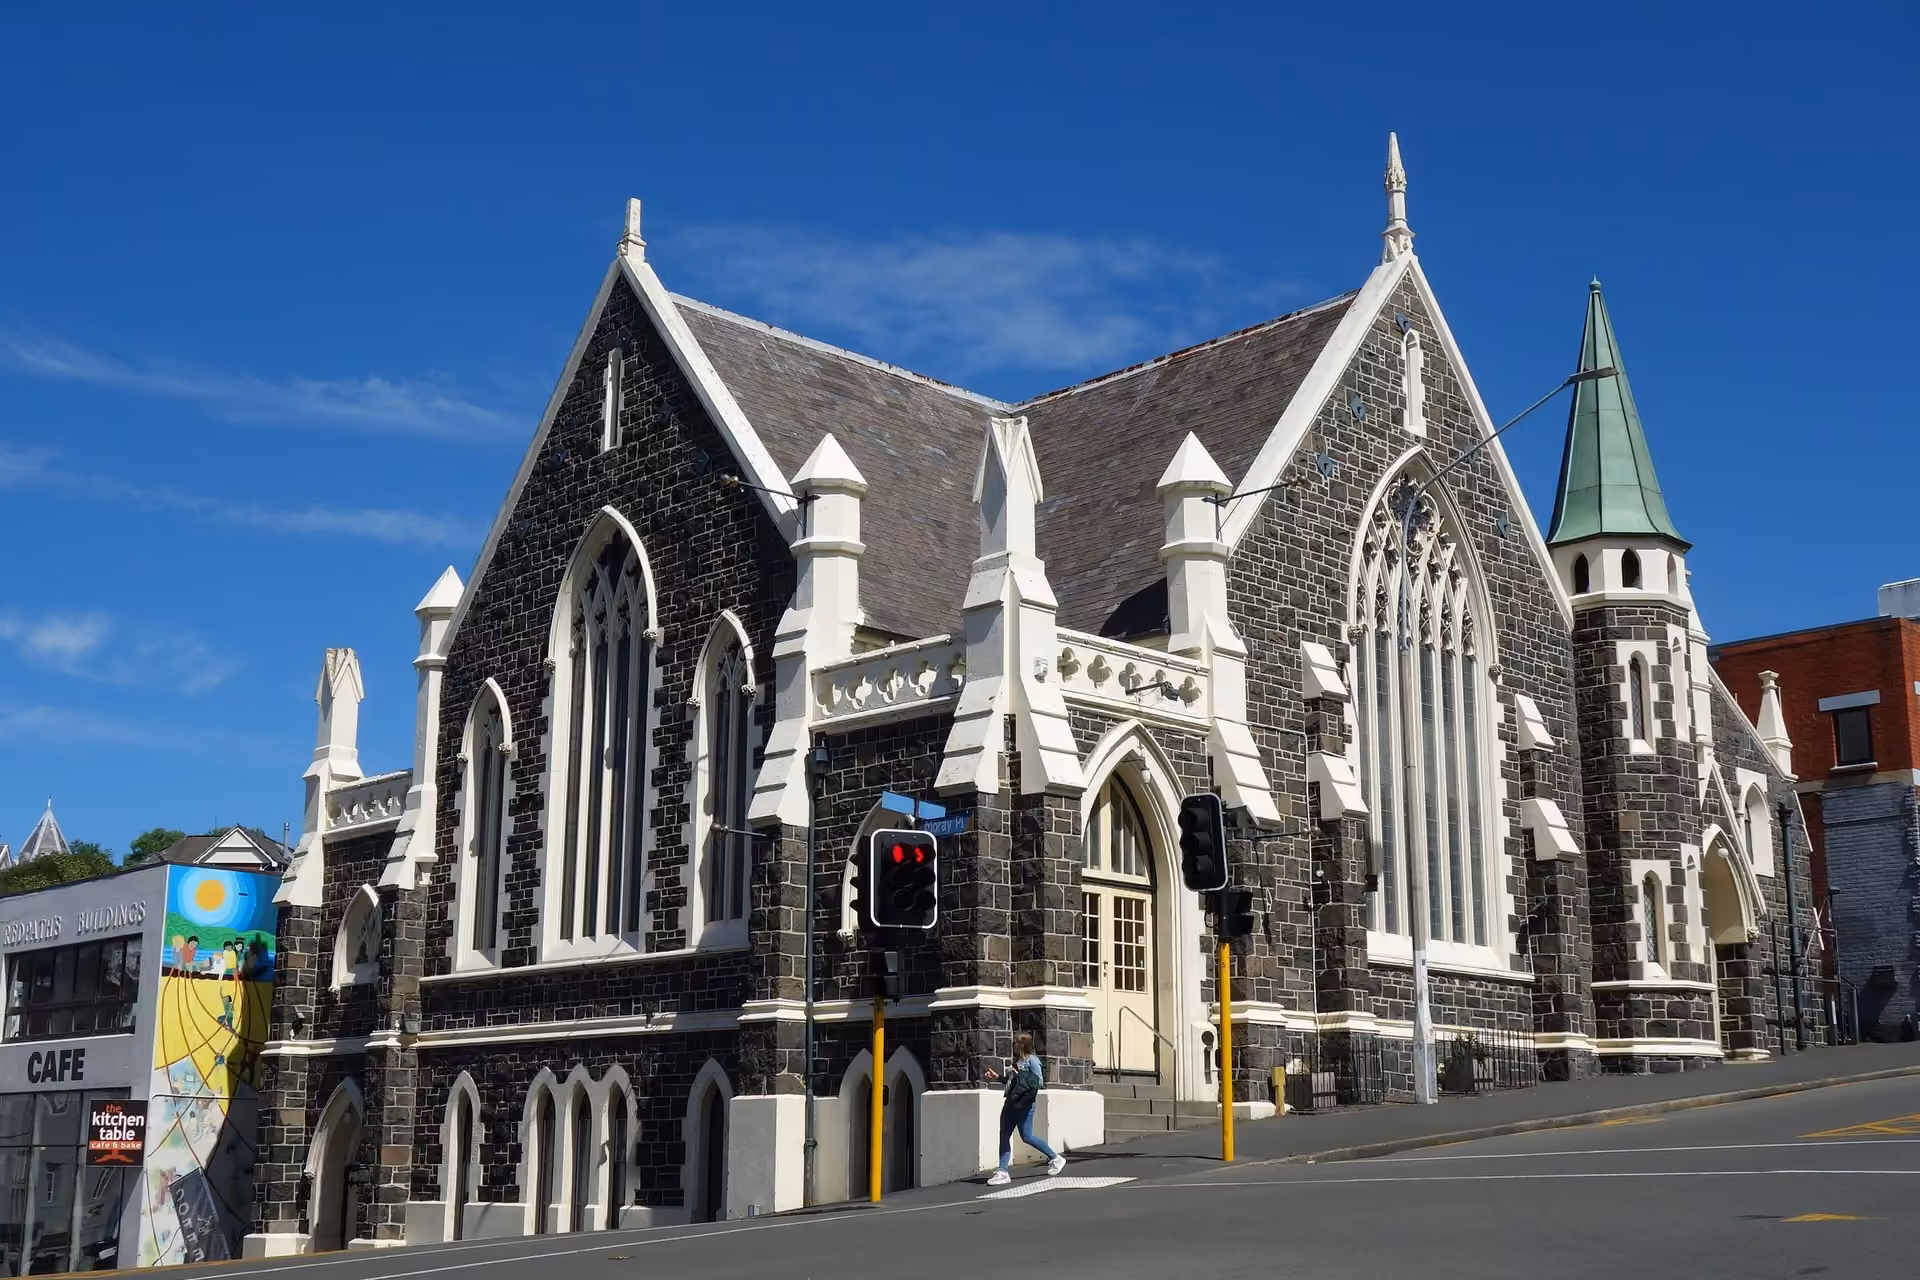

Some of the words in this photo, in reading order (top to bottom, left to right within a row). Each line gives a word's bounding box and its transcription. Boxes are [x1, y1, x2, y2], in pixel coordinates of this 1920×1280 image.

[77, 900, 146, 934] BUILDINGS
[27, 1048, 86, 1084] CAFE
[105, 1104, 122, 1113] the
[92, 1111, 145, 1127] kitchen
[99, 1126, 136, 1141] table
[91, 1141, 111, 1149] cafe
[120, 1141, 142, 1149] bake
